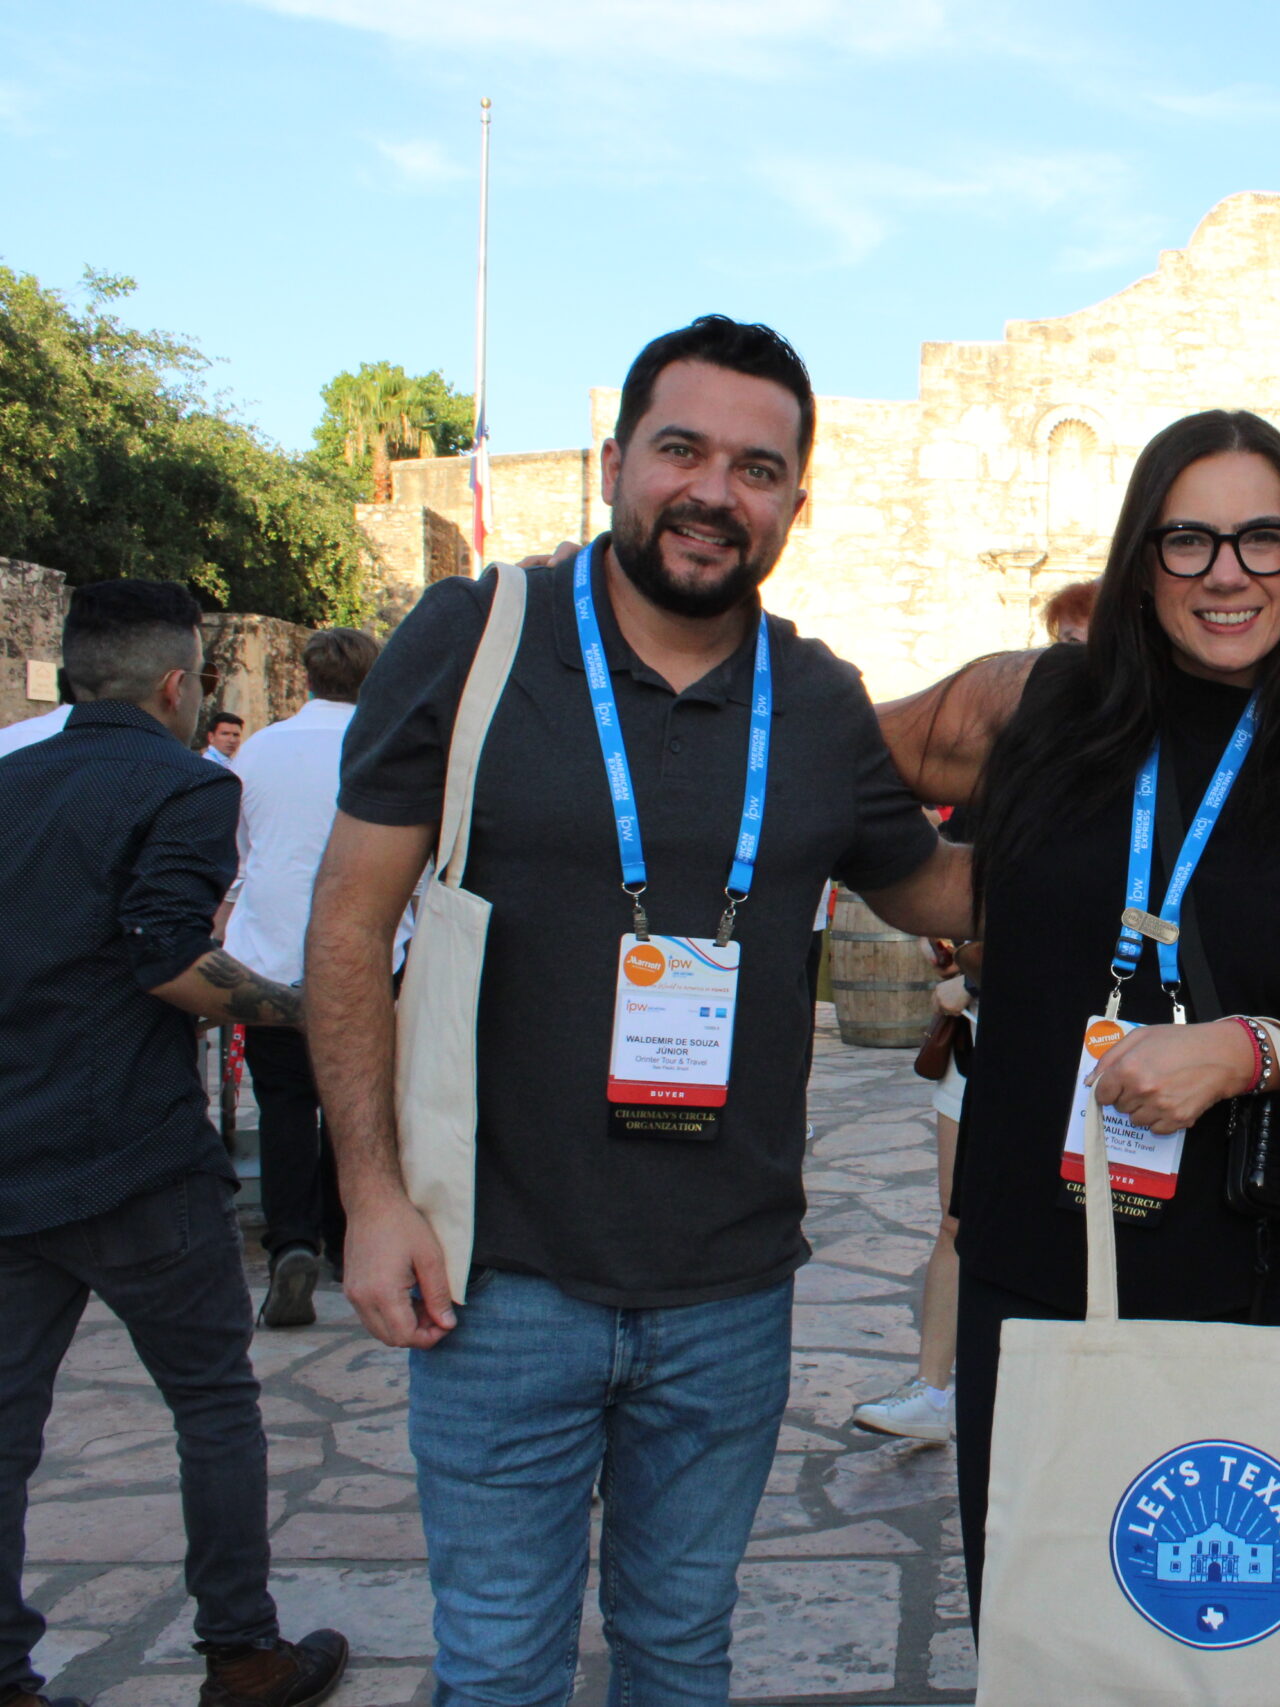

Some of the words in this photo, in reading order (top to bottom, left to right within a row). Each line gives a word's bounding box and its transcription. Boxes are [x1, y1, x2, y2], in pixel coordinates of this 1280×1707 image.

[577, 596, 590, 620] ipw
[585, 649, 600, 690] EXPRESS
[591, 643, 608, 689] AMERICAN
[595, 702, 613, 727] ipw
[753, 694, 769, 717] ipw
[750, 727, 761, 772] AMERICAN
[758, 729, 767, 769] EXPRESS
[1234, 729, 1253, 751] ipw
[607, 758, 622, 801] EXPRESS
[614, 752, 631, 801] AMERICAN
[1136, 774, 1152, 797] ipw
[1211, 769, 1235, 809] AMERICAN
[743, 796, 760, 821] ipw
[617, 815, 635, 842] ipw
[1133, 809, 1144, 854] AMERICAN
[1141, 809, 1151, 849] EXPRESS
[1193, 817, 1214, 840] ipw
[1128, 878, 1144, 902] ipw
[668, 955, 693, 971] ipw
[626, 1000, 648, 1012] ipw
[626, 1035, 673, 1045] WALDEMIR
[675, 1038, 687, 1046] DE
[690, 1039, 720, 1047] SOUZA
[662, 1056, 677, 1064] Tour
[686, 1058, 707, 1066] Travel
[615, 1110, 678, 1120] CHAIRMAN'S
[680, 1112, 716, 1121] CIRCLE
[626, 1121, 703, 1131] ORGANIZATION
[1111, 1136, 1125, 1145] Tour
[1134, 1141, 1156, 1152] Travel
[1108, 1175, 1135, 1184] UYER
[1127, 1196, 1163, 1209] CIRCLE
[1128, 1460, 1200, 1537] LET'S
